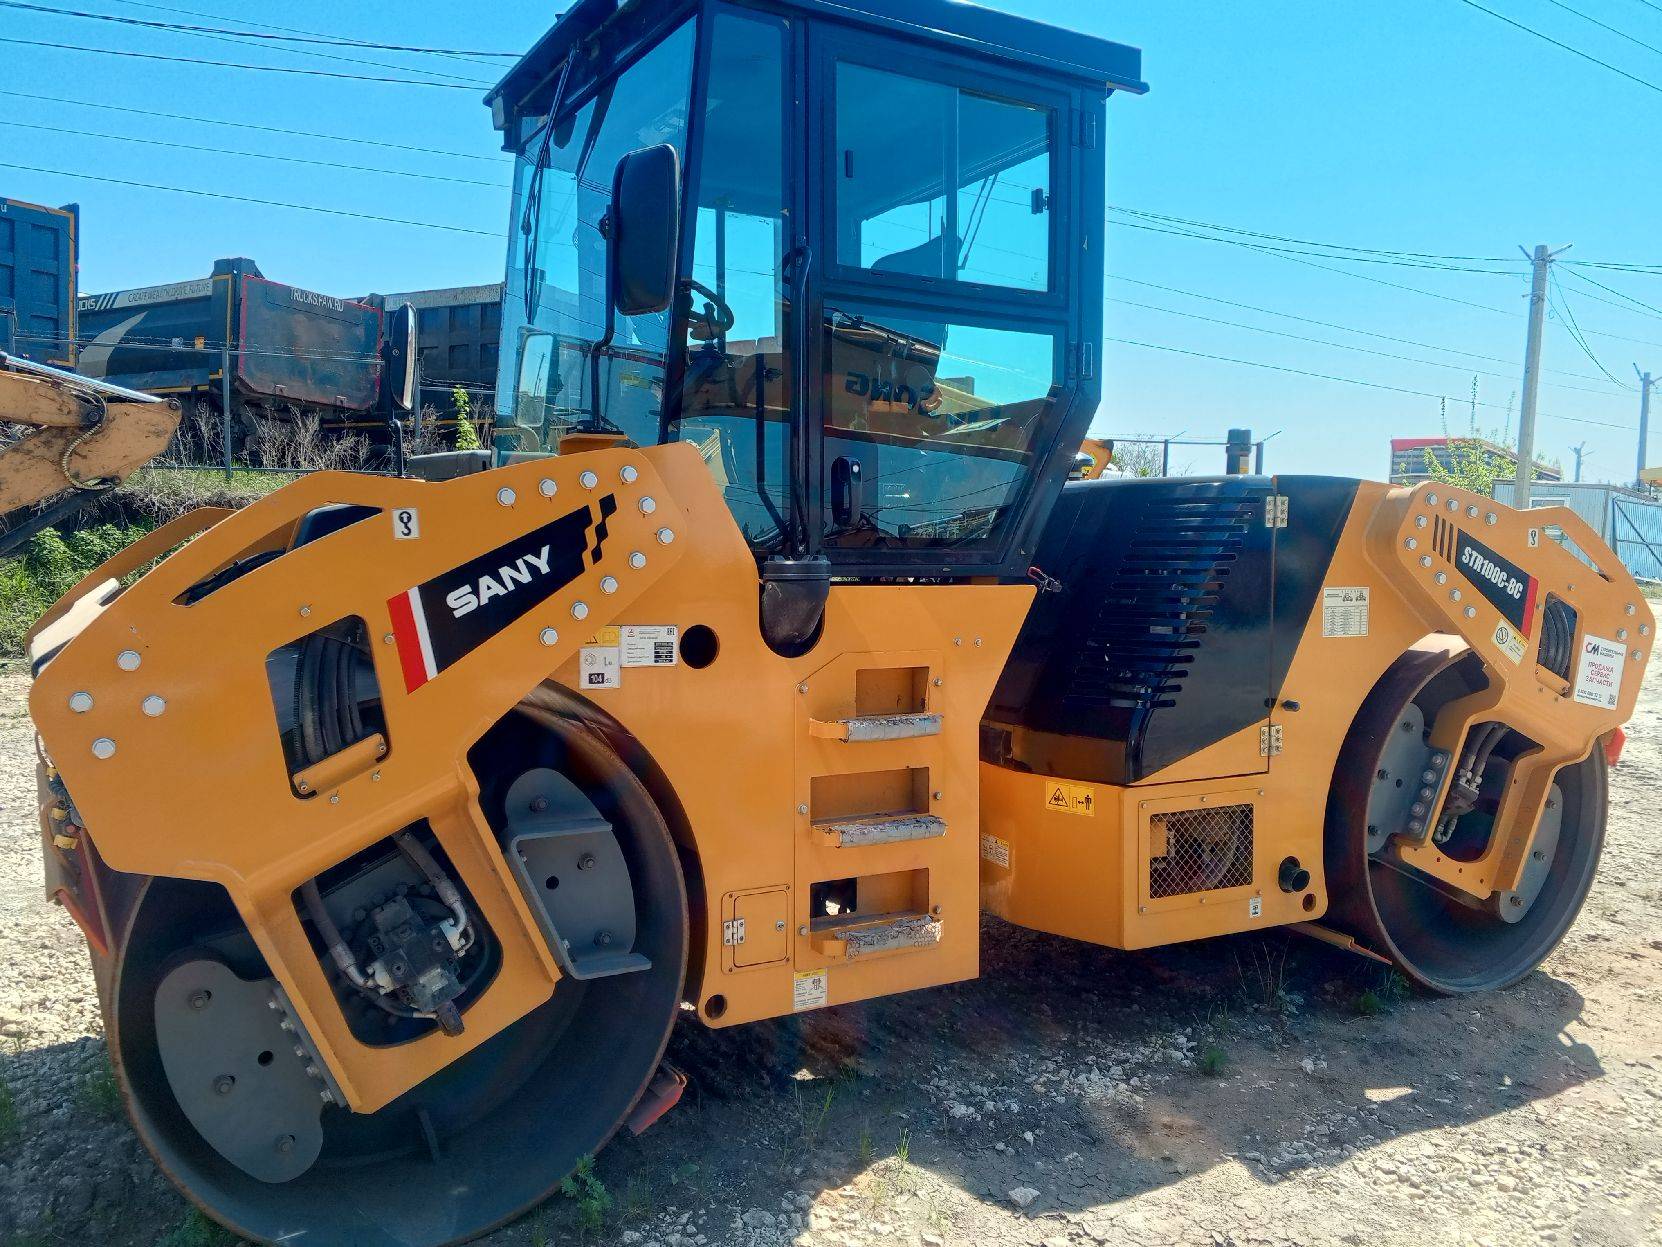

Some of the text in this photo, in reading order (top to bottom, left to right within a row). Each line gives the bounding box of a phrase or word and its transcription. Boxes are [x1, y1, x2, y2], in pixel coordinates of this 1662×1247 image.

[290, 287, 344, 312] TRUCKS.FAW.RU
[445, 543, 552, 619] SANY
[1461, 546, 1524, 600] STR100C-8C
[1588, 661, 1614, 673] ПРОДАЖА
